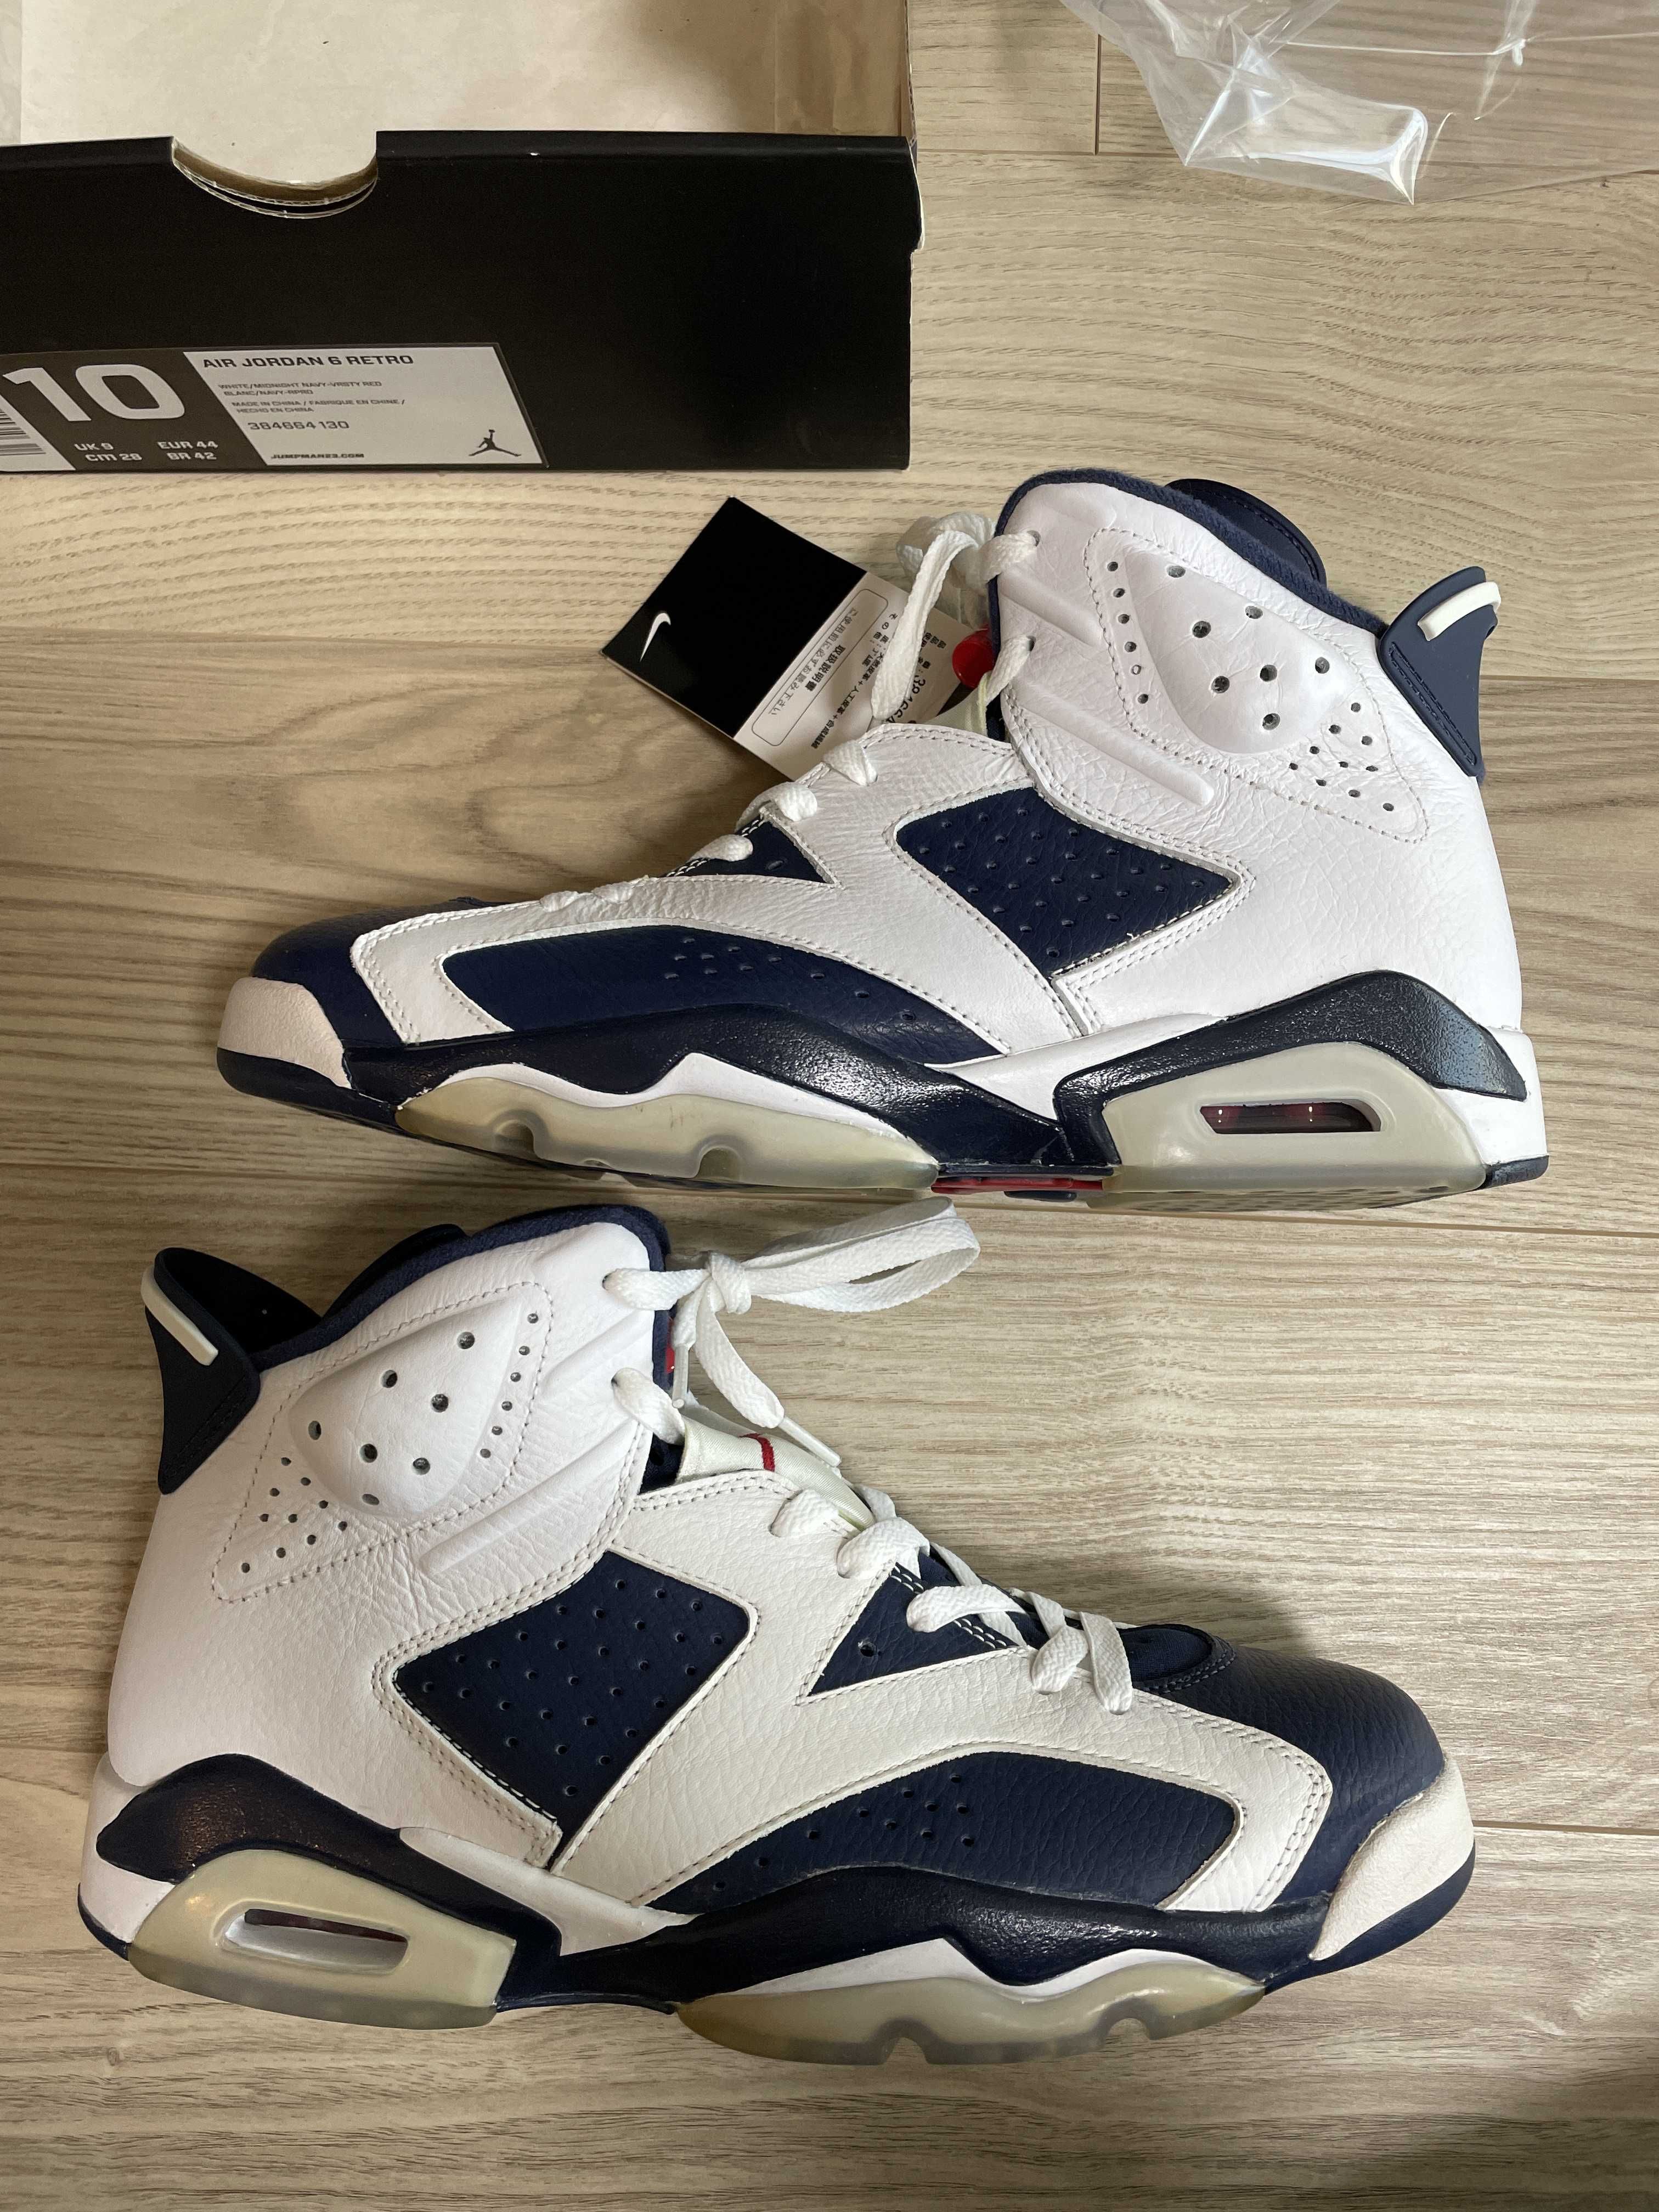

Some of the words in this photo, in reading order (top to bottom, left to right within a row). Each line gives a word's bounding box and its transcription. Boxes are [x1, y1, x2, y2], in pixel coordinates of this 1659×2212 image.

[204, 358, 237, 368] AIR
[242, 357, 324, 367] JORDAN
[328, 356, 342, 365] 6
[346, 355, 414, 365] RETRO
[2, 364, 185, 422] 10
[248, 421, 317, 430] 384664
[319, 421, 349, 429] 130
[157, 441, 193, 449] EUR
[196, 441, 218, 449] 44
[166, 452, 191, 460] BR
[804, 645, 845, 691] 取扱説明書
